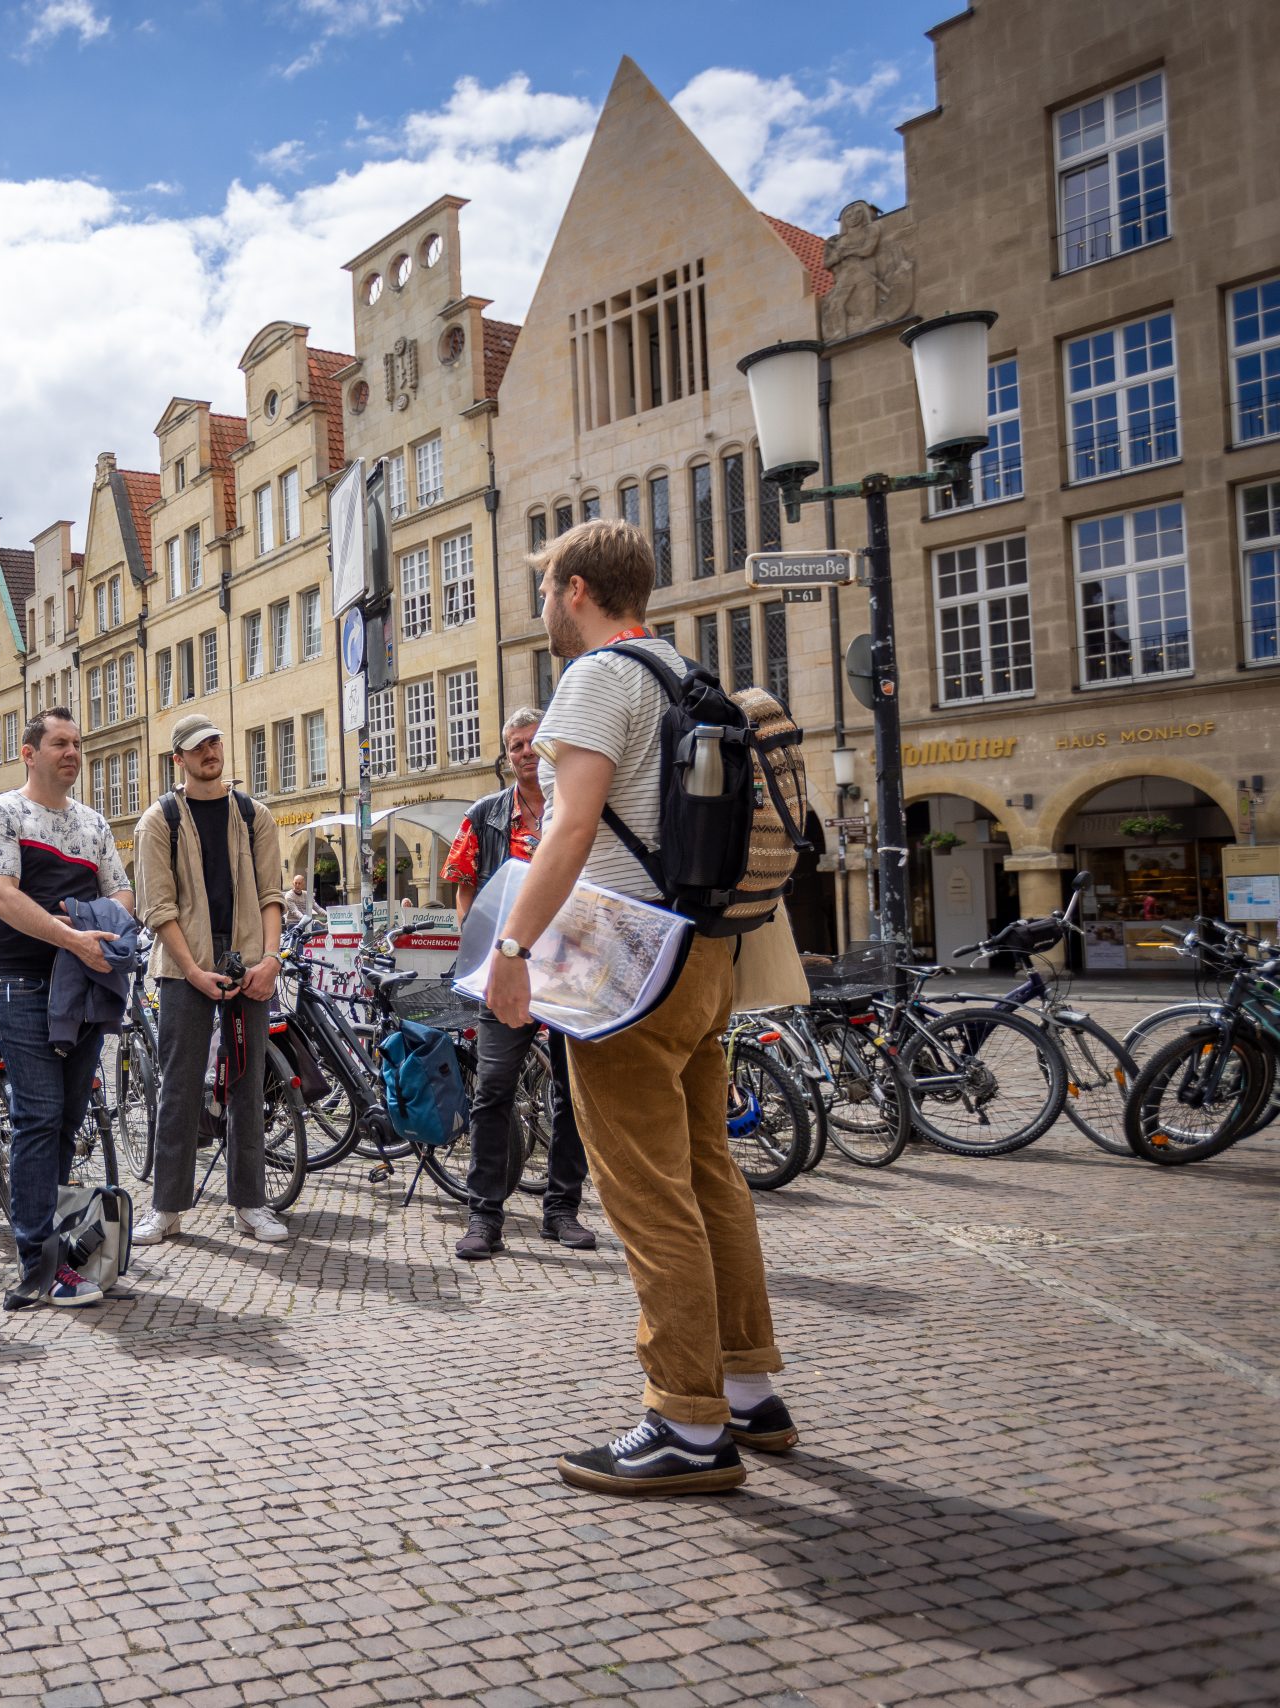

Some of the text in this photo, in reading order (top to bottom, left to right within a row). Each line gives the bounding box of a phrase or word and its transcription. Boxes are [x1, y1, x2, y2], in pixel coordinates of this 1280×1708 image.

[758, 559, 845, 578] Salzstraße
[1055, 721, 1216, 750] HAUS MONHOF
[412, 912, 455, 923] nadann.de
[218, 1063, 226, 1086] Canon
